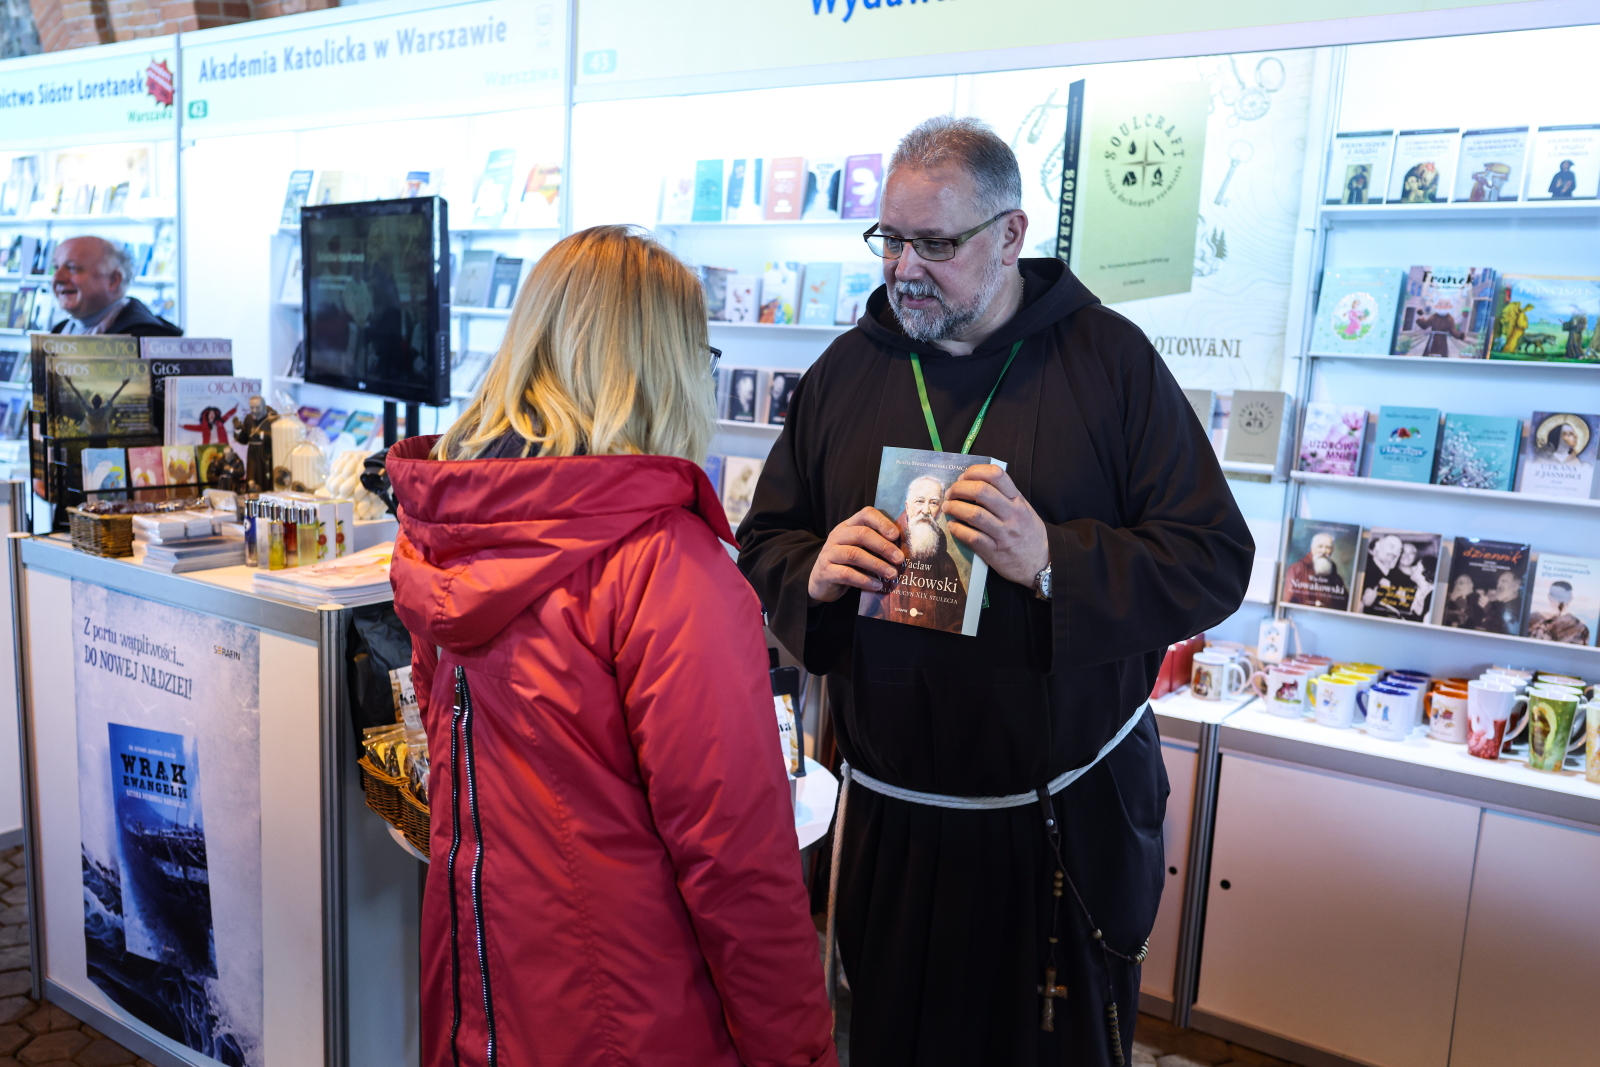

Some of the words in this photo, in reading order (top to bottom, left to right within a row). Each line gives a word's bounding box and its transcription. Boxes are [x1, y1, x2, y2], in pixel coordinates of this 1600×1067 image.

[198, 48, 278, 83] Akademia
[283, 35, 367, 71] Katolicka
[373, 38, 390, 59] w
[396, 16, 508, 56] Warszawie
[589, 53, 610, 72] 43
[484, 66, 559, 87] Warszawa
[38, 81, 74, 105] Sióstr
[77, 69, 145, 102] Loretanek
[127, 109, 173, 123] Warszawa
[1104, 113, 1185, 160] SOULCRAFT
[1056, 169, 1076, 262] SOULCRAF
[1420, 270, 1476, 286] Franek
[115, 341, 137, 354] PIO
[212, 341, 232, 354] PIO
[1148, 336, 1243, 359] OTOWANI
[126, 362, 149, 376] PIO
[207, 381, 238, 396] OJCA
[241, 381, 262, 394] PIO
[1462, 547, 1523, 564] dziennik
[902, 558, 933, 572] Wacław
[1290, 578, 1345, 595] Nowakowski
[915, 591, 928, 600] XIX
[84, 616, 91, 636] Z
[93, 625, 117, 644] portu
[213, 644, 241, 661] SERAFIN
[84, 645, 97, 667] DO
[99, 650, 138, 681] NOWEJ
[120, 752, 188, 785] WRAK
